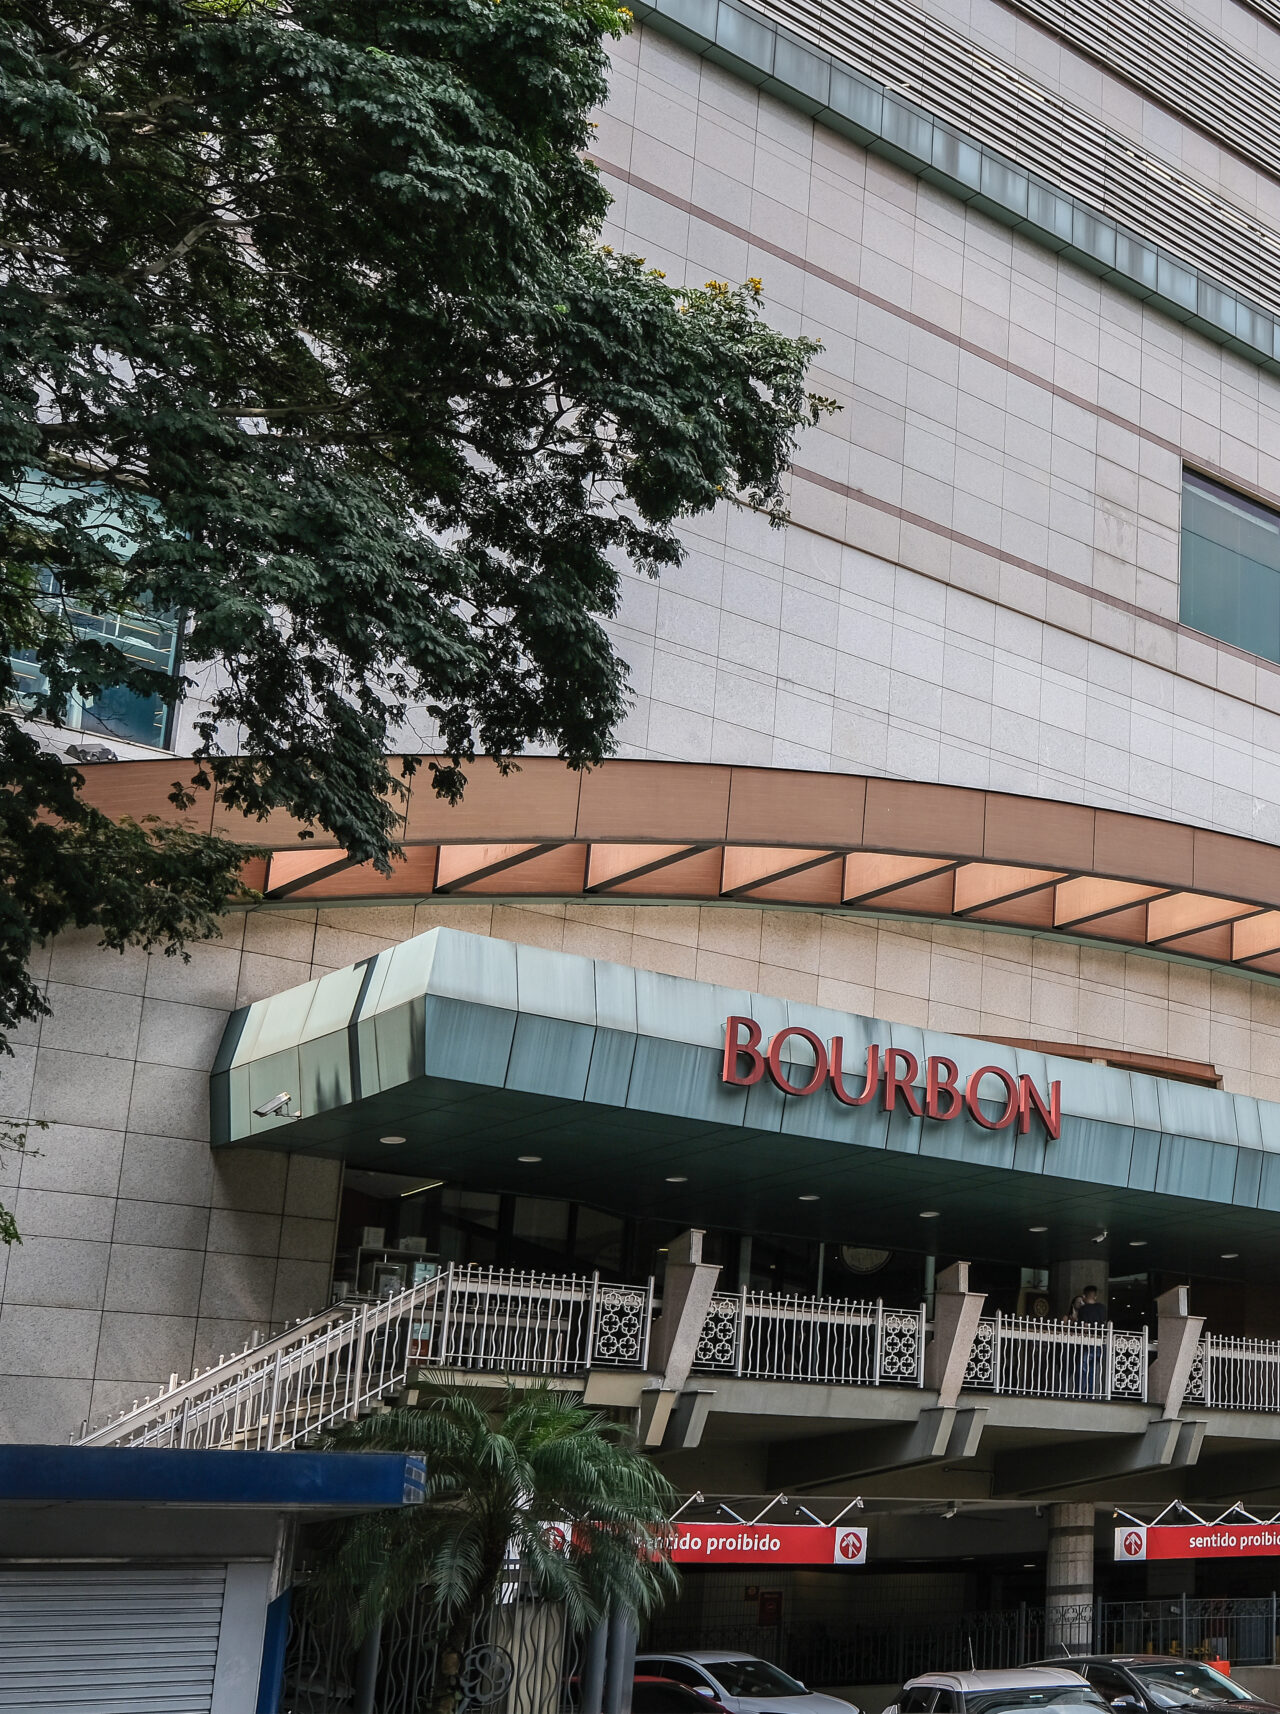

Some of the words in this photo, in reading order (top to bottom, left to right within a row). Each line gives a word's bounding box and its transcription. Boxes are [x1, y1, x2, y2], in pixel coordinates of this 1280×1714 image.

[722, 1015, 1061, 1140] BOURBON
[706, 1534, 781, 1555] proibido
[1189, 1532, 1237, 1548] sentido
